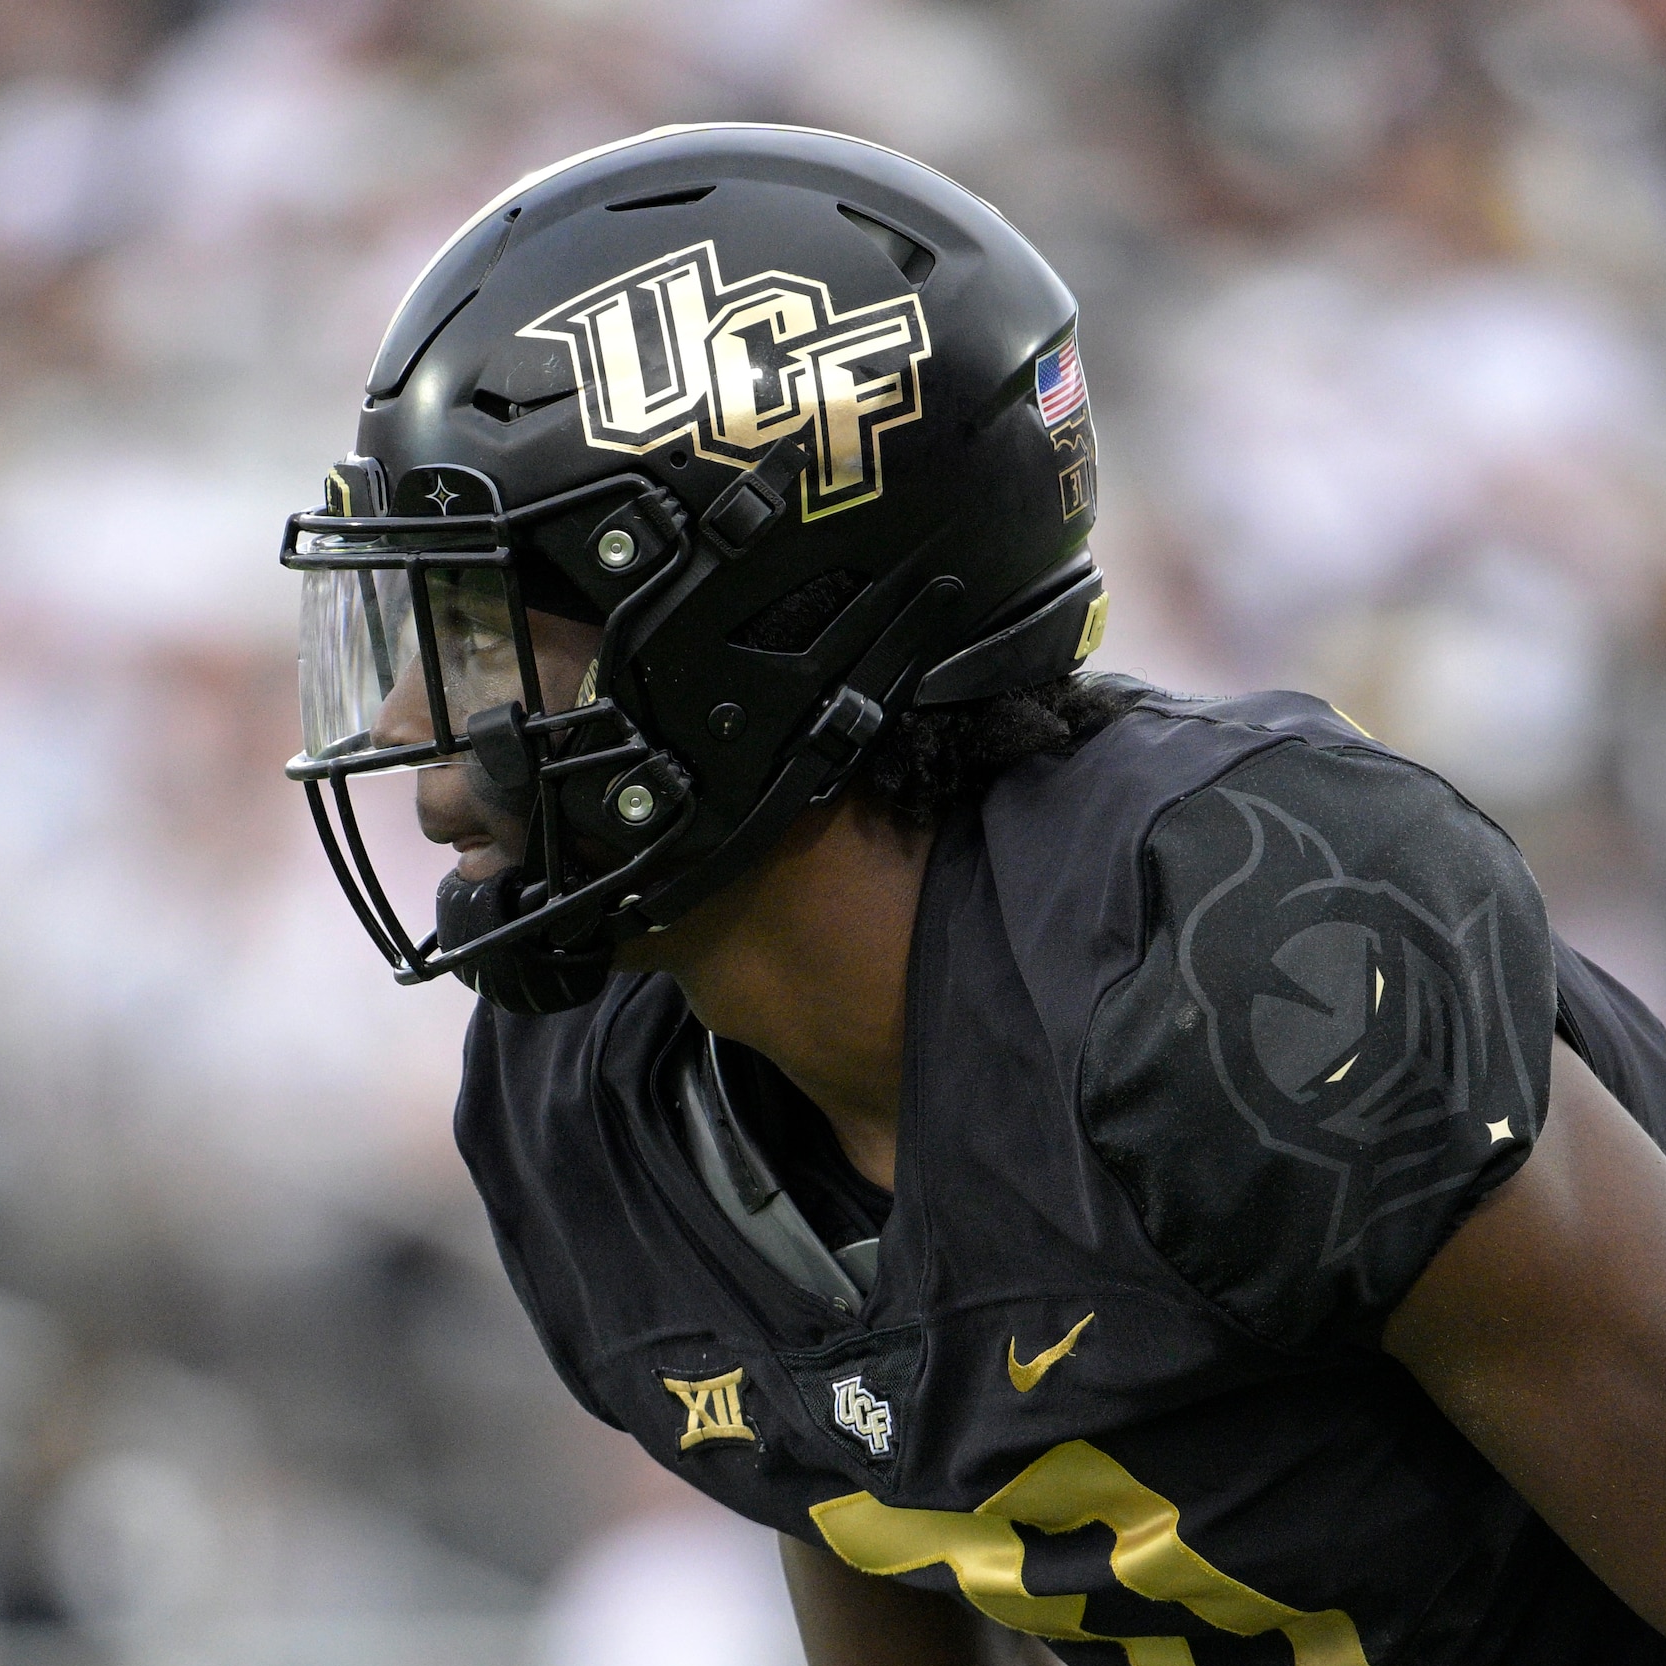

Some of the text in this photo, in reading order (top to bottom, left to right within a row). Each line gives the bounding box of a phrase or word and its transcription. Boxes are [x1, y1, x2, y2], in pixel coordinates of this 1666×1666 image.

[514, 239, 932, 523] UCF
[662, 1367, 756, 1450] XII
[832, 1376, 892, 1455] UCF
